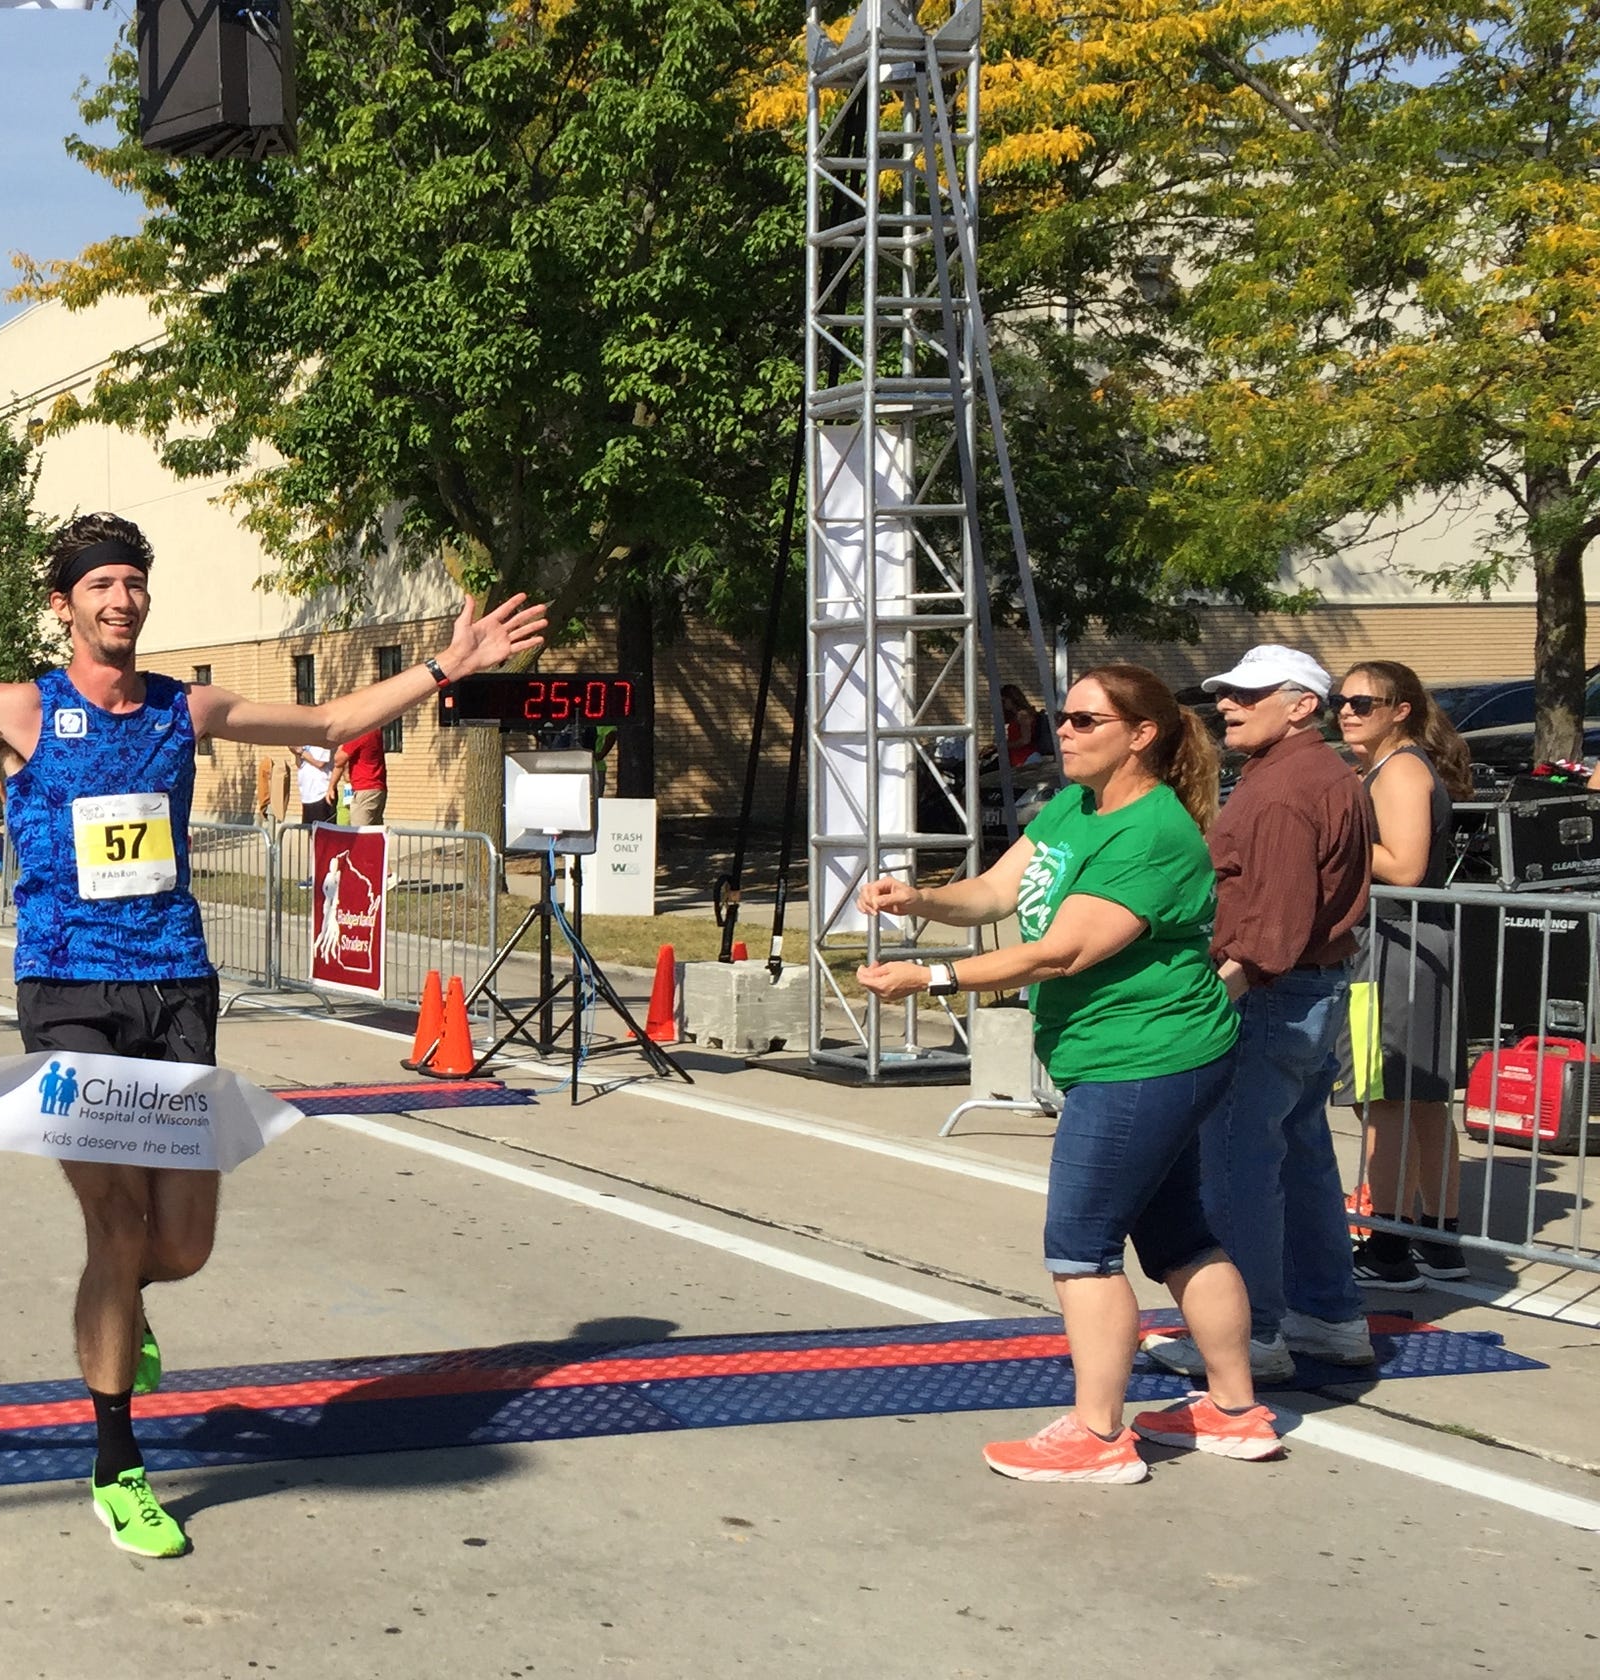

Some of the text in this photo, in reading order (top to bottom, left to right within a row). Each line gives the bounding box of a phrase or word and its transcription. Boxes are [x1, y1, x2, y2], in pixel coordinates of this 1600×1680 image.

[104, 822, 148, 862] 57
[611, 832, 643, 841] TRASH
[613, 843, 639, 853] ONLY
[337, 909, 375, 930] Badgerland
[1504, 917, 1568, 929] CLEARWNG
[341, 934, 369, 952] Striders
[81, 1078, 208, 1112] Children's
[79, 1107, 210, 1127] Hospital of Wisconsin
[42, 1131, 73, 1147] Kids
[77, 1134, 138, 1151] deserve
[143, 1140, 167, 1154] the
